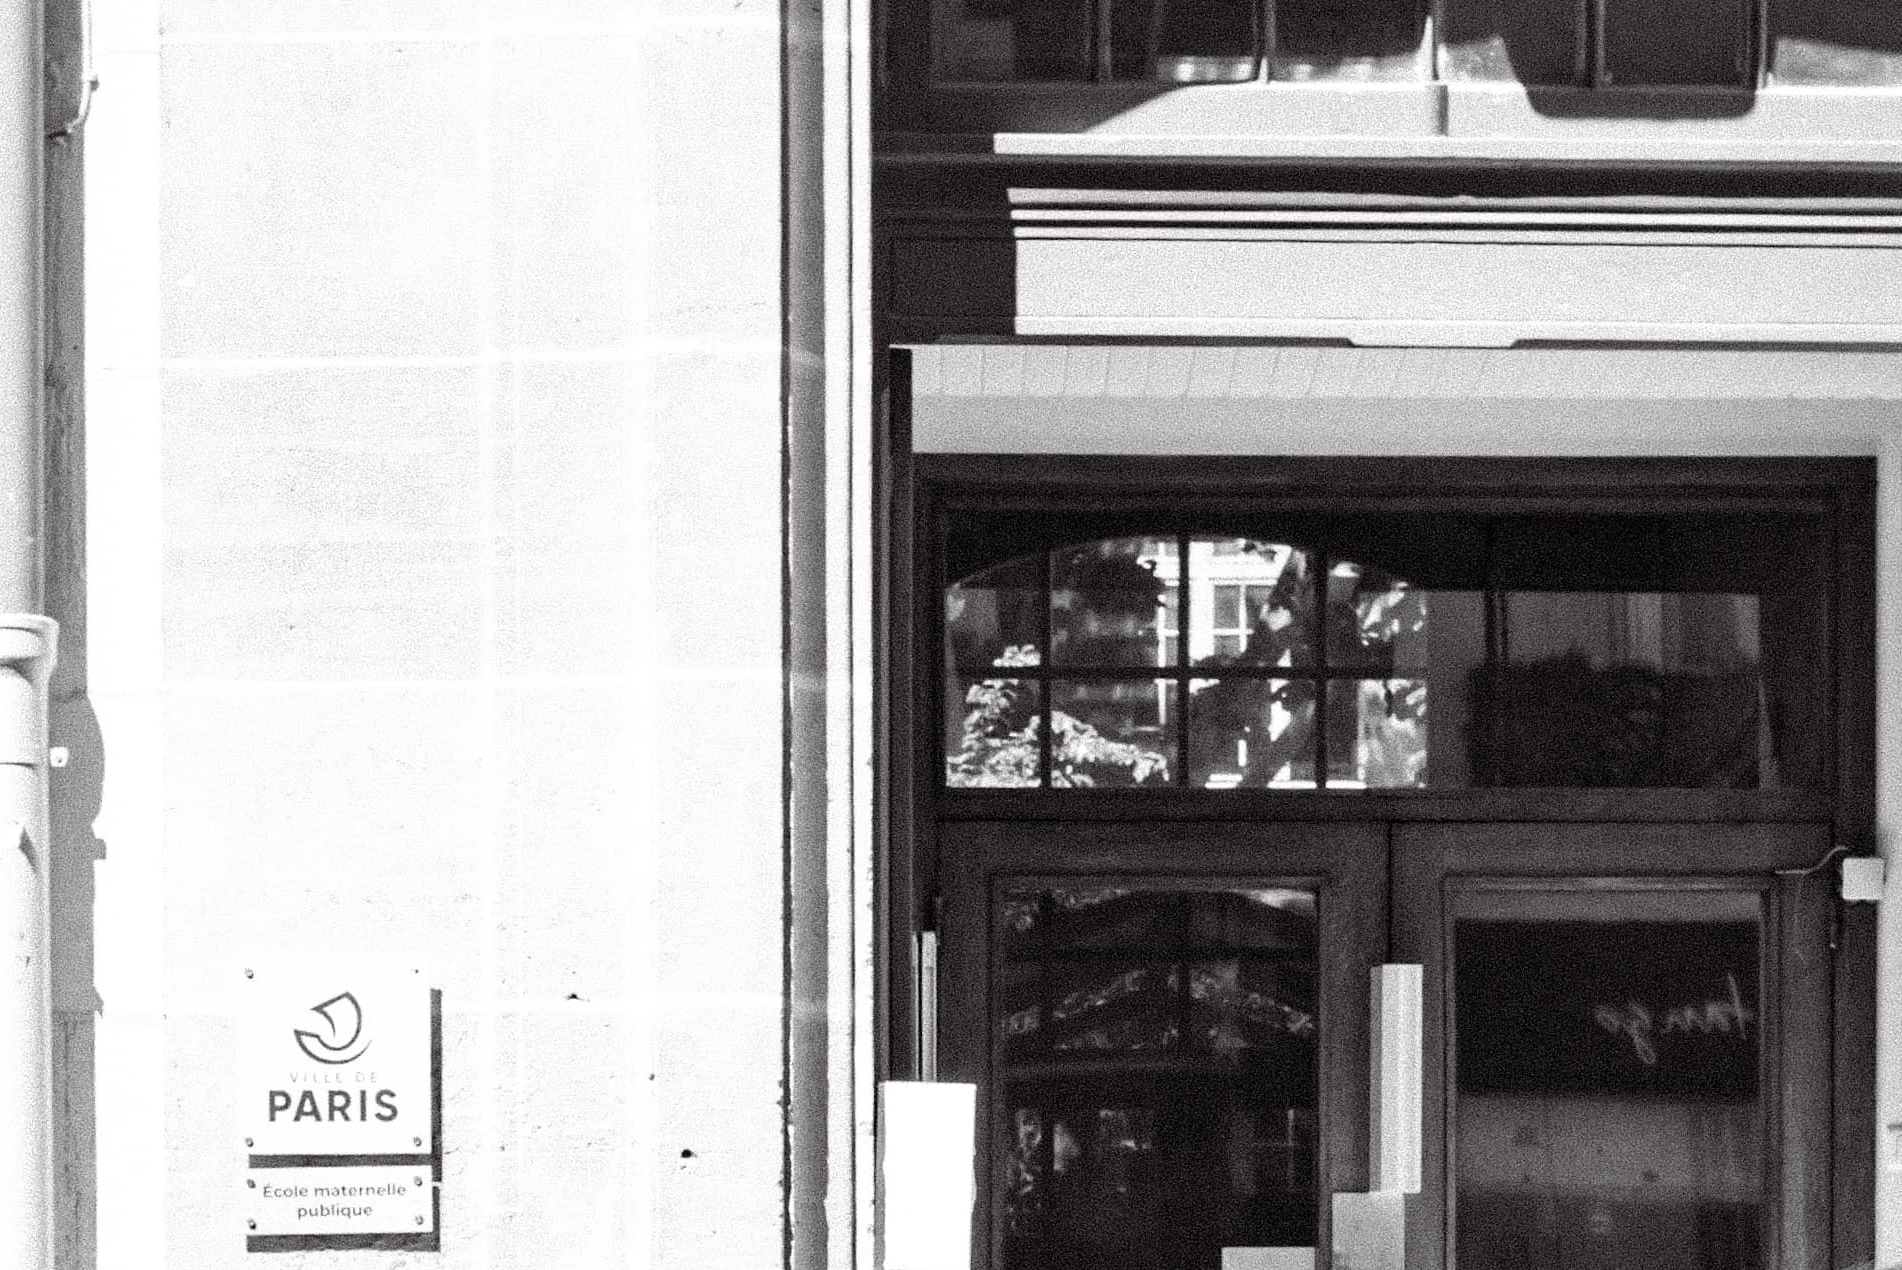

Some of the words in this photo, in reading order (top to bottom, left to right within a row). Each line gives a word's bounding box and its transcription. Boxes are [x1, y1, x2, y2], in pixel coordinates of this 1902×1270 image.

[289, 1071, 343, 1084] VILLE
[355, 1071, 378, 1084] DE
[268, 1089, 399, 1122] PARIS
[263, 1182, 308, 1198] École
[314, 1183, 406, 1197] maternelle
[298, 1203, 373, 1219] publique
